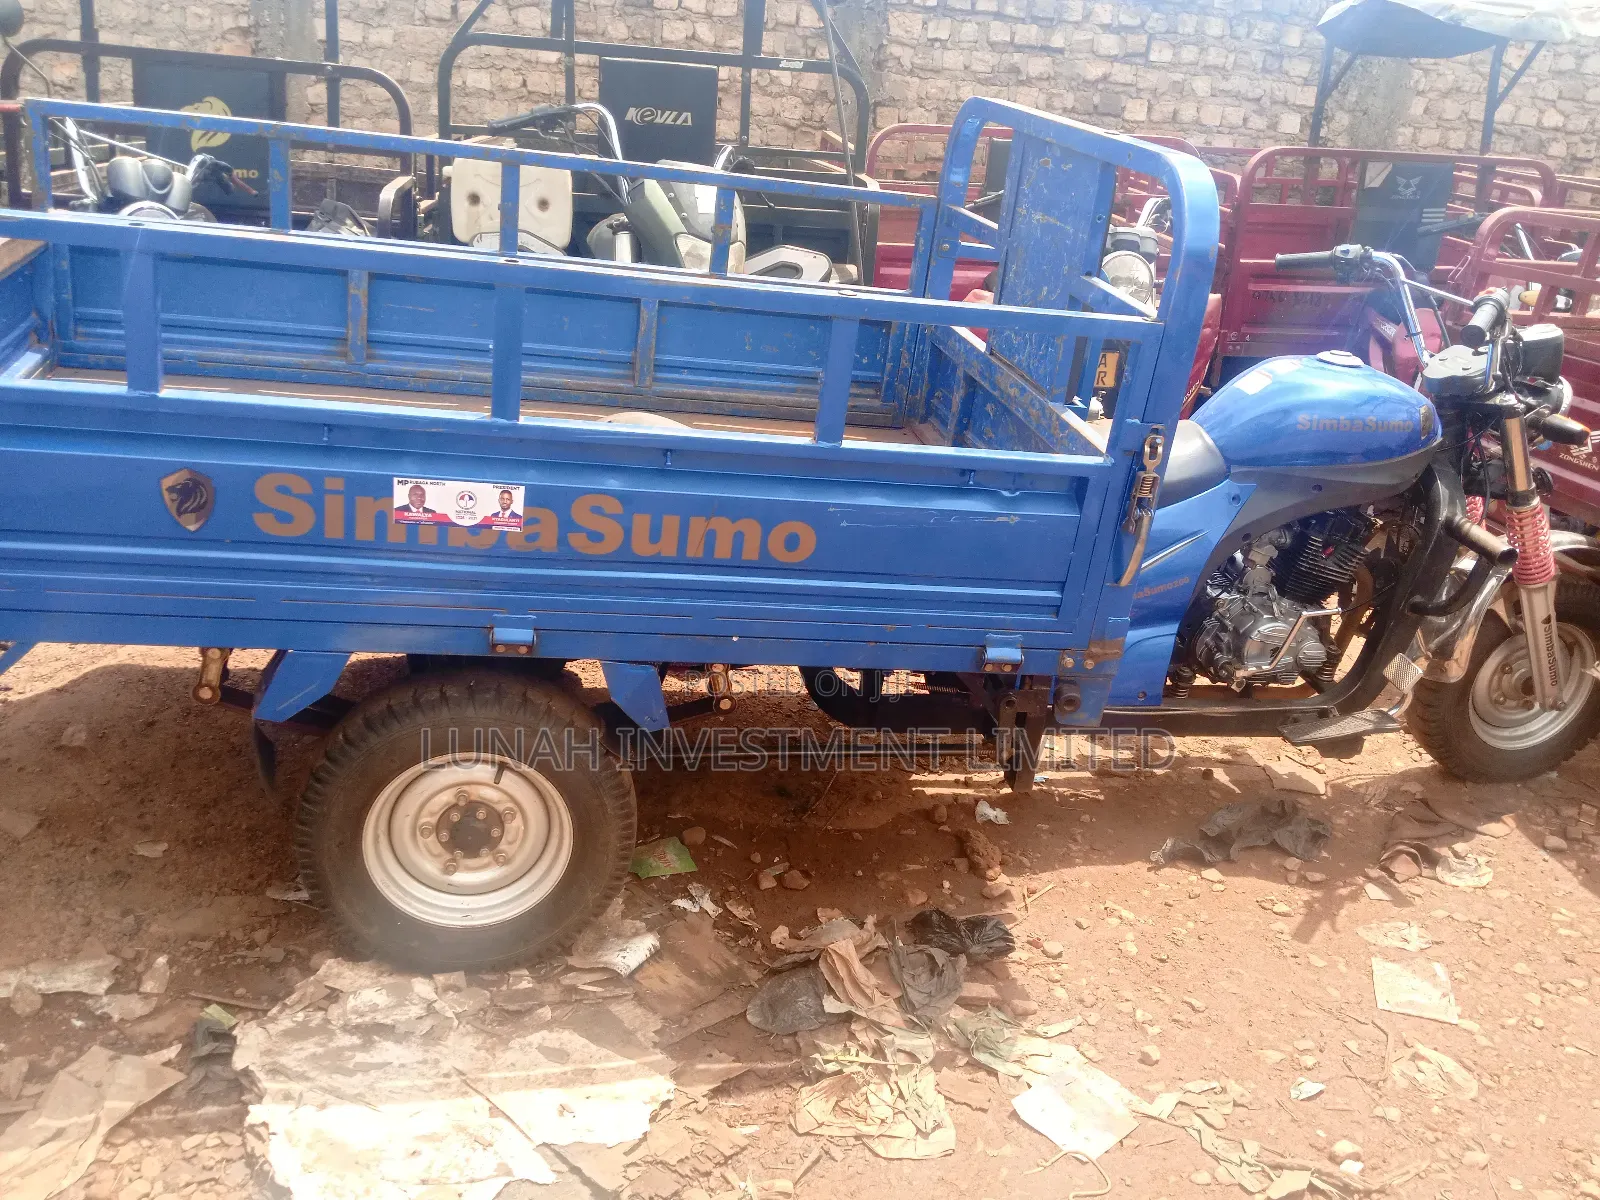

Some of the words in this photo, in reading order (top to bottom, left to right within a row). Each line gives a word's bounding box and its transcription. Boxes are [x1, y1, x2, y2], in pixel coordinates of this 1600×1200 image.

[1296, 413, 1414, 432] SimbaSumo
[1559, 453, 1599, 471] ZONGSHEN
[1544, 624, 1558, 687] SimbaSumo
